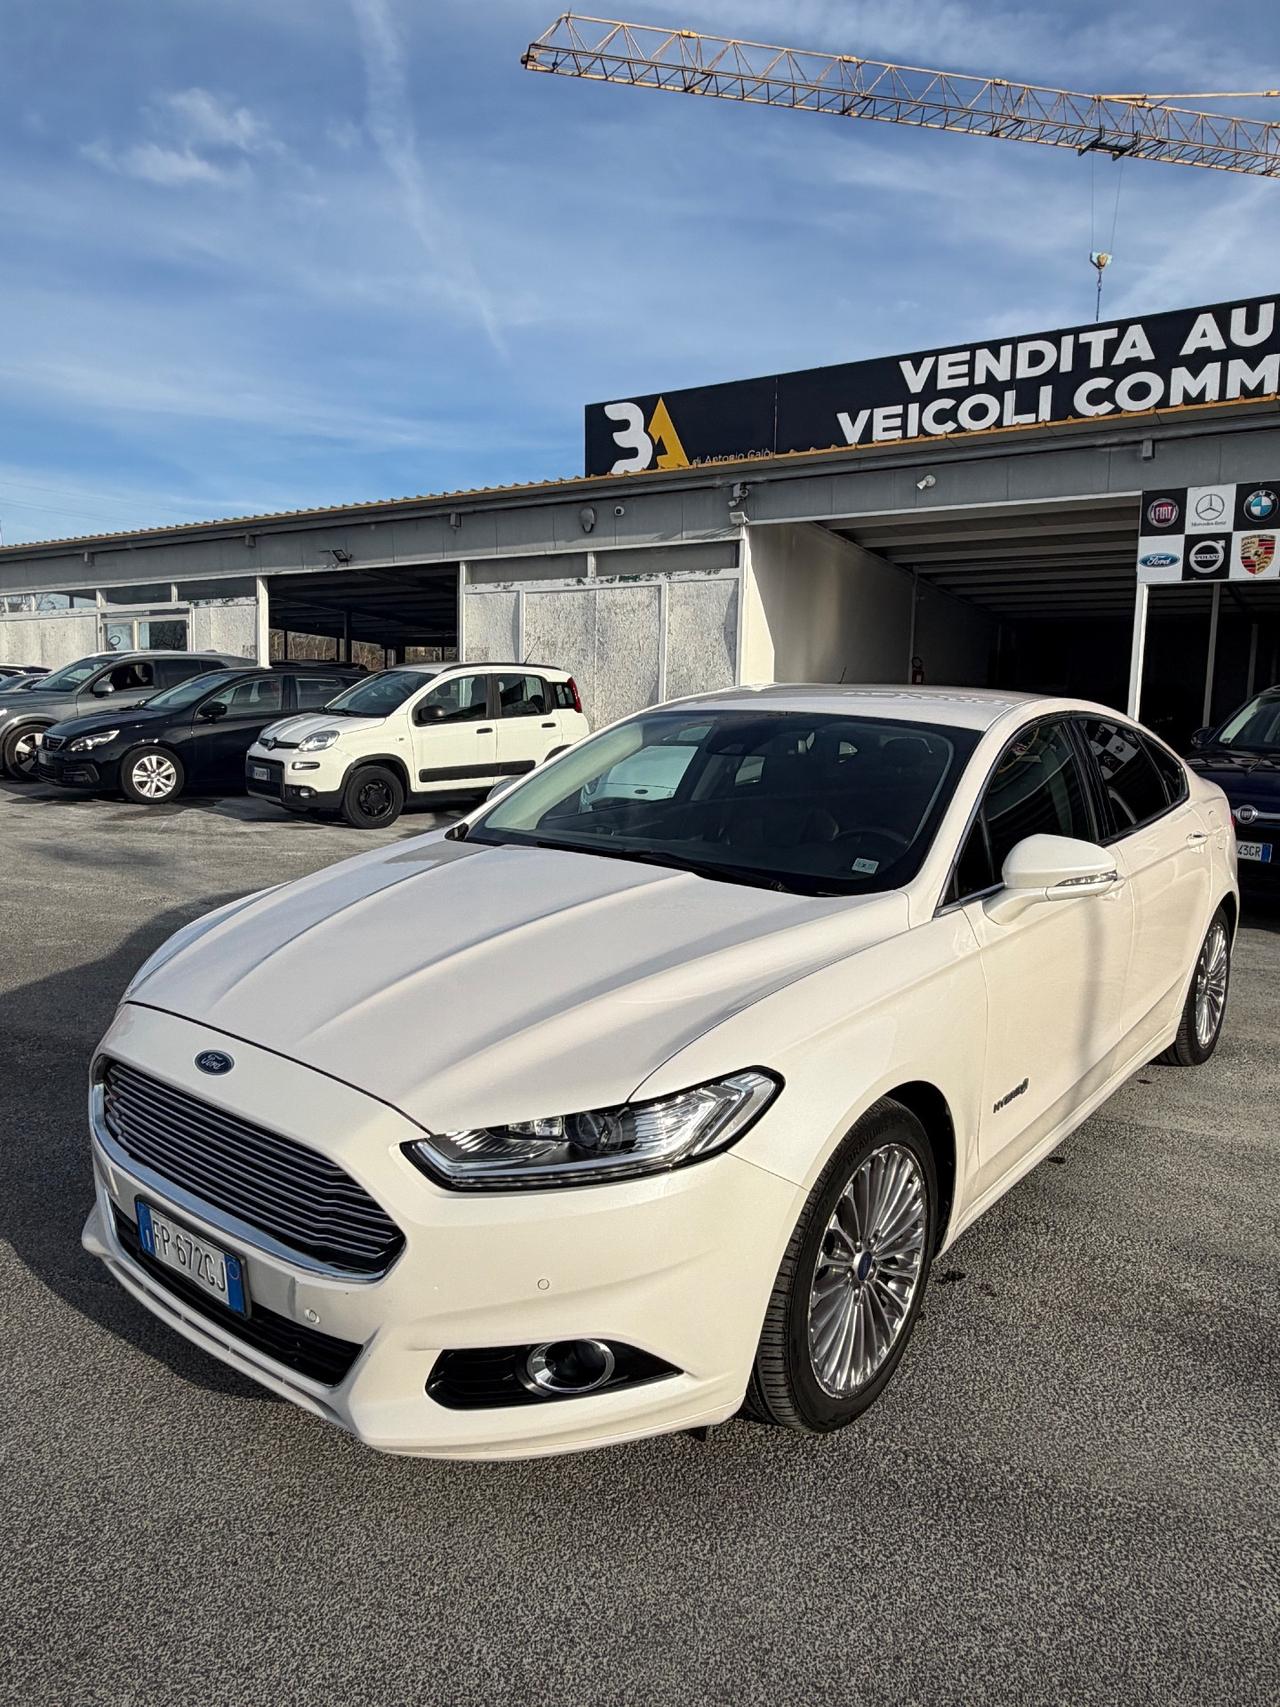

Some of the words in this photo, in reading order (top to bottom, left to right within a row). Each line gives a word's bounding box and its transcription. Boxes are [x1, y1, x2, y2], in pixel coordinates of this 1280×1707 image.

[899, 324, 1155, 393] VENDITA
[837, 385, 1053, 444] VEICOLI
[1074, 354, 1280, 416] COMM
[1155, 506, 1172, 520] FIAT
[1147, 555, 1172, 565] Ford
[152, 1219, 170, 1256] FP
[175, 1233, 226, 1292] 672GJ
